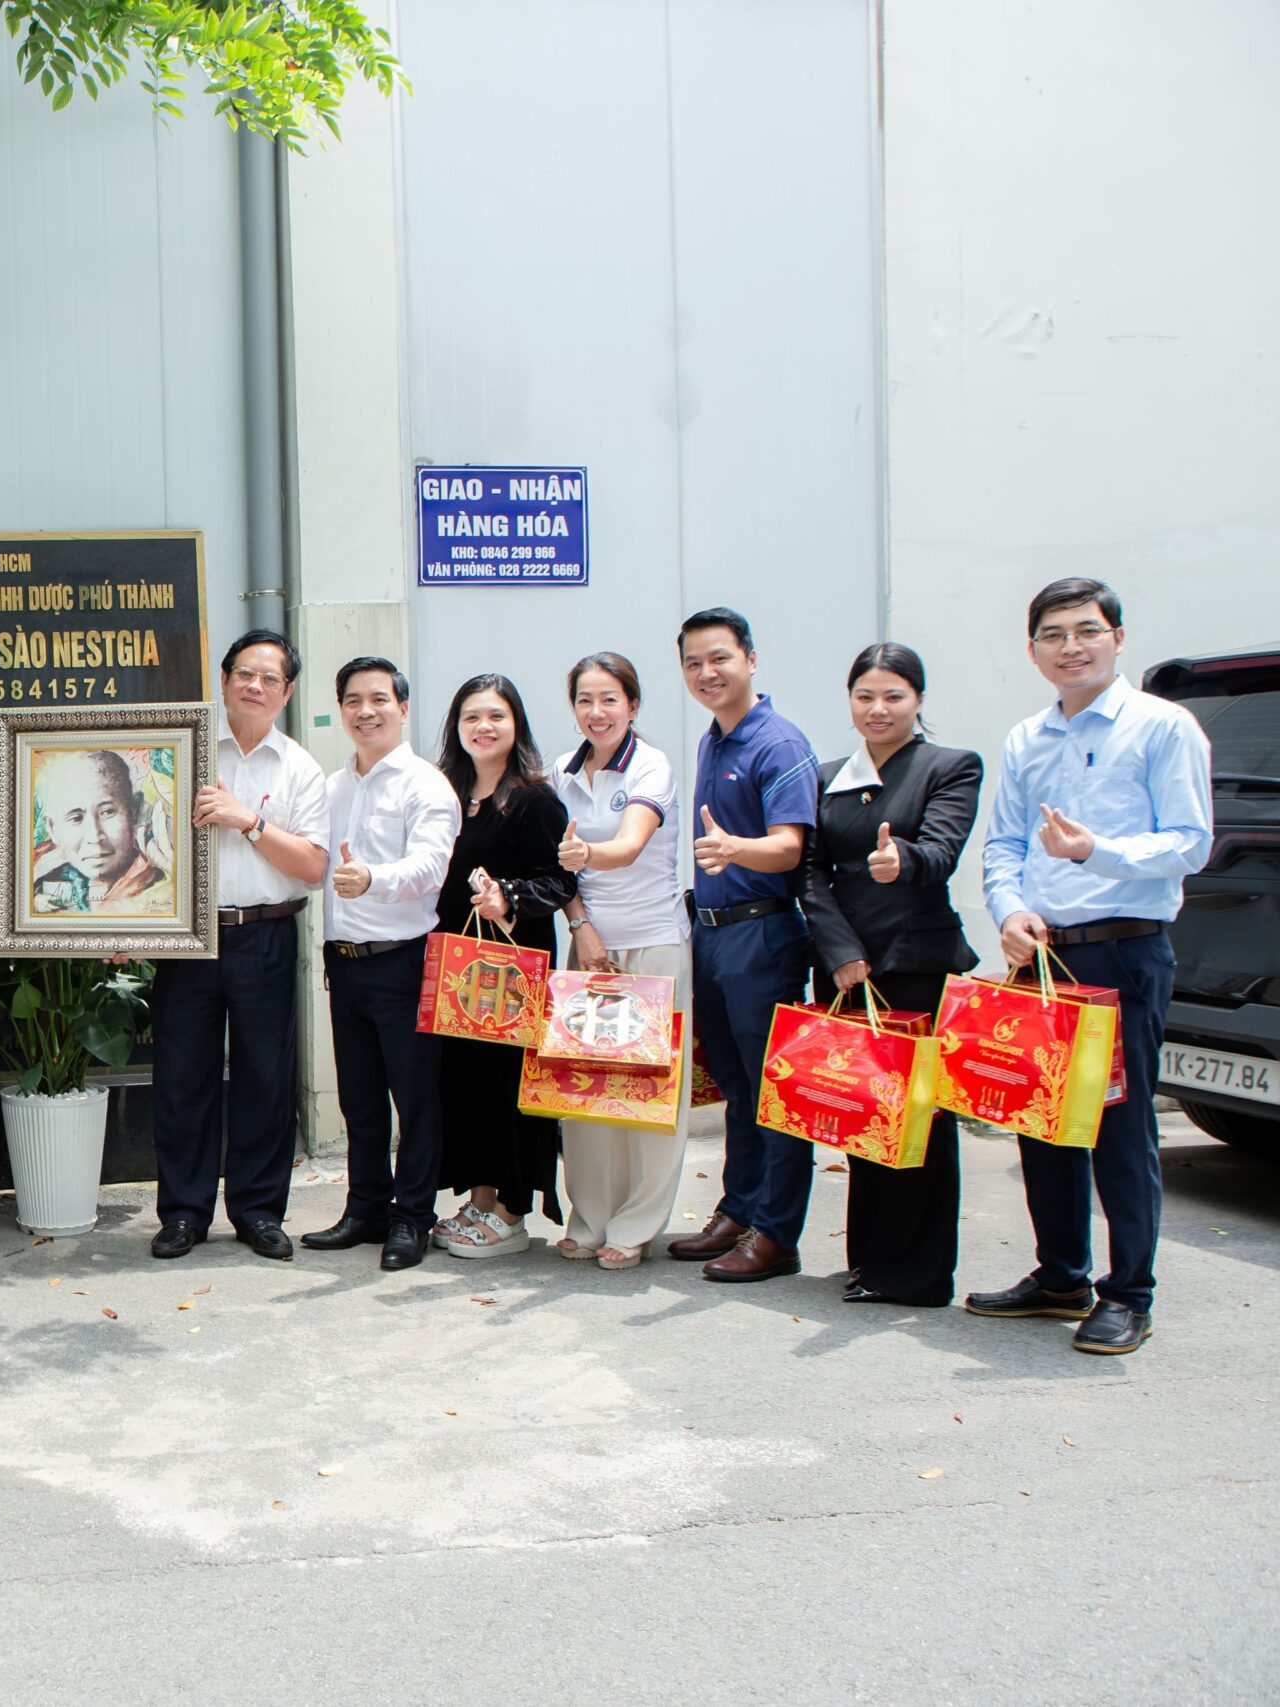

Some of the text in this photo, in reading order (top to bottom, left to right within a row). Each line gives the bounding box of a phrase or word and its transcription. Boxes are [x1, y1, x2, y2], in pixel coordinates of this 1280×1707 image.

[422, 478, 483, 501] GIAO
[509, 475, 582, 505] NHẬN
[437, 510, 569, 537] HÀNG HÓA
[451, 546, 556, 559] KHO: 0846 299 966
[427, 561, 580, 577] VĂN PHÒNG: 028 2222 6669
[29, 582, 74, 616] DƯỢC
[78, 579, 113, 611] PHÚ
[117, 578, 174, 610] THÀNH
[52, 629, 160, 668] NESTGIA
[1163, 1051, 1270, 1093] 1K-277.84
